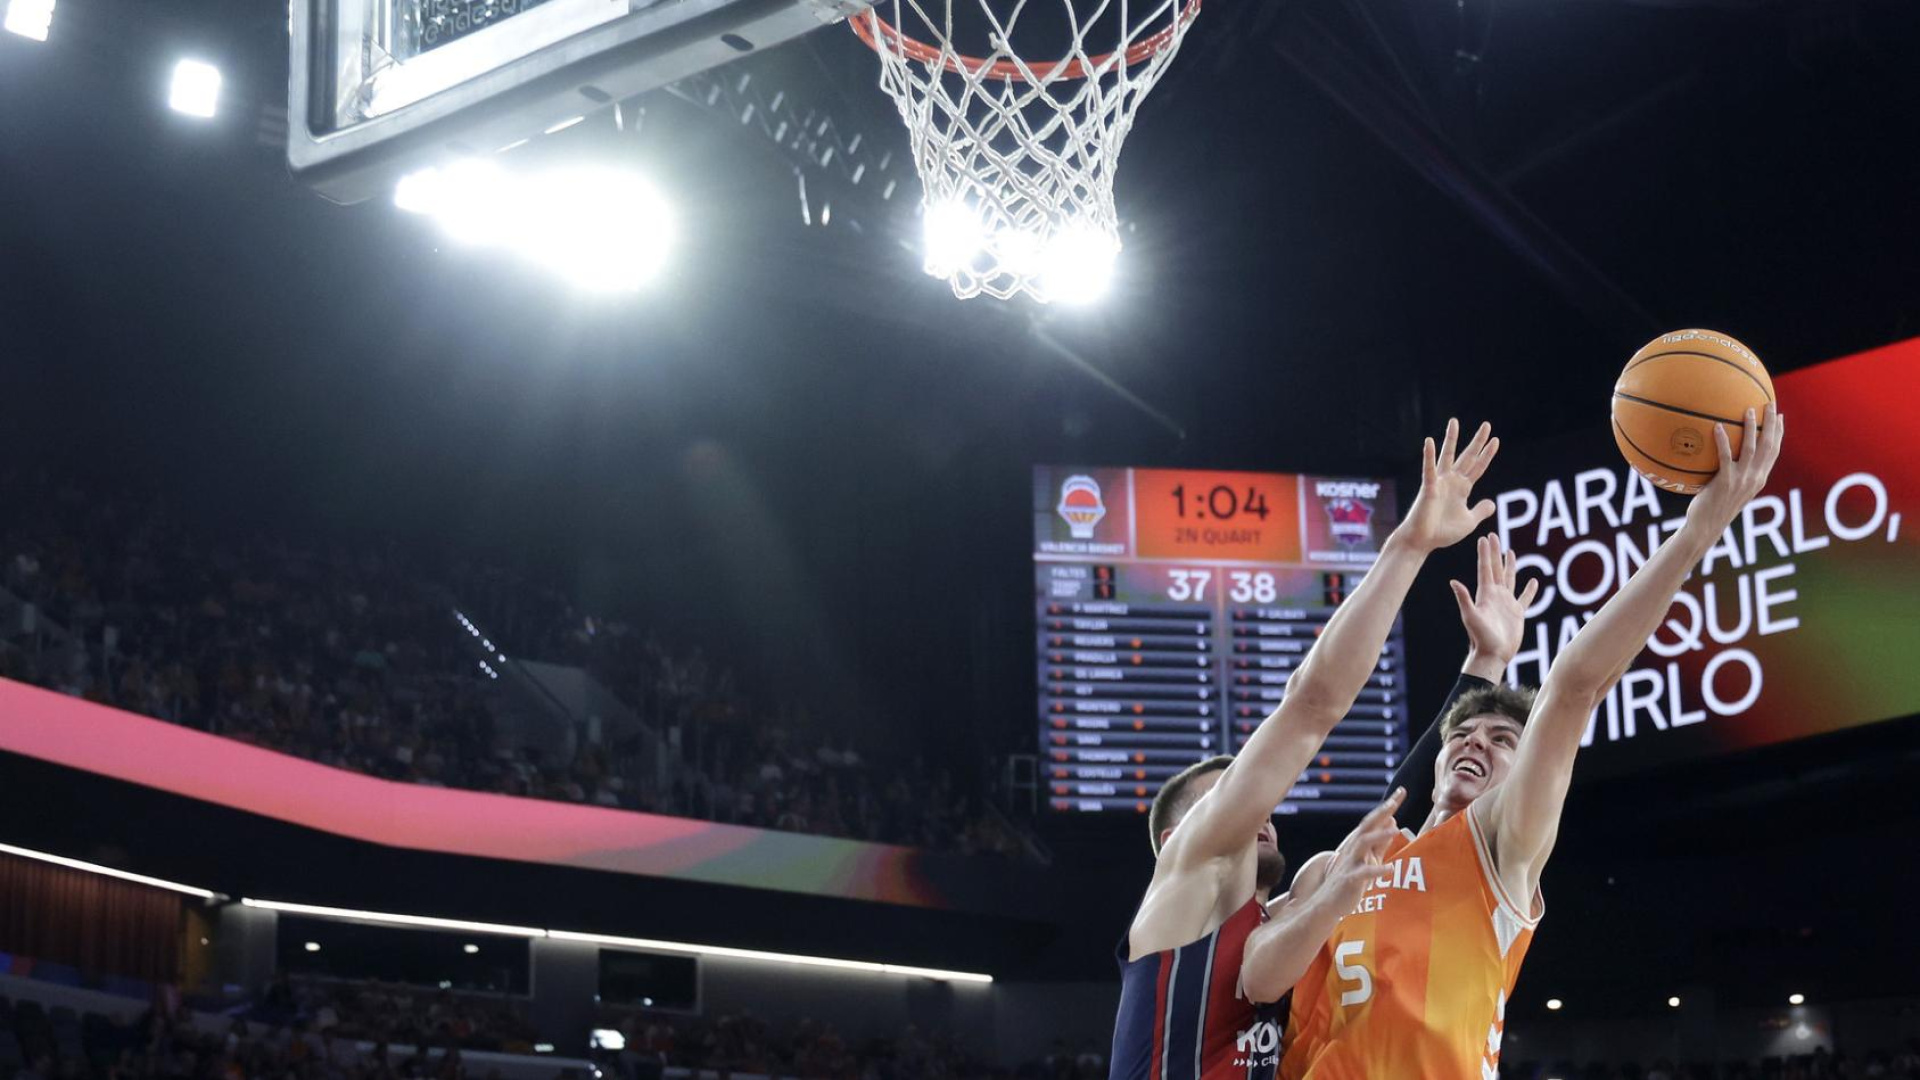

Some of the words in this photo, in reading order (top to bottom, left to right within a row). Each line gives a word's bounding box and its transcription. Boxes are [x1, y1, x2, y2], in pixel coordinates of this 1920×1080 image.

[1172, 484, 1270, 521] 1:04
[1497, 467, 1661, 554] PARA
[1175, 528, 1197, 544] 2N
[1203, 528, 1261, 545] QUART
[1168, 569, 1212, 601] 37
[1230, 571, 1276, 603] 38
[1647, 563, 1800, 657] QUE
[1335, 940, 1375, 1007] 5
